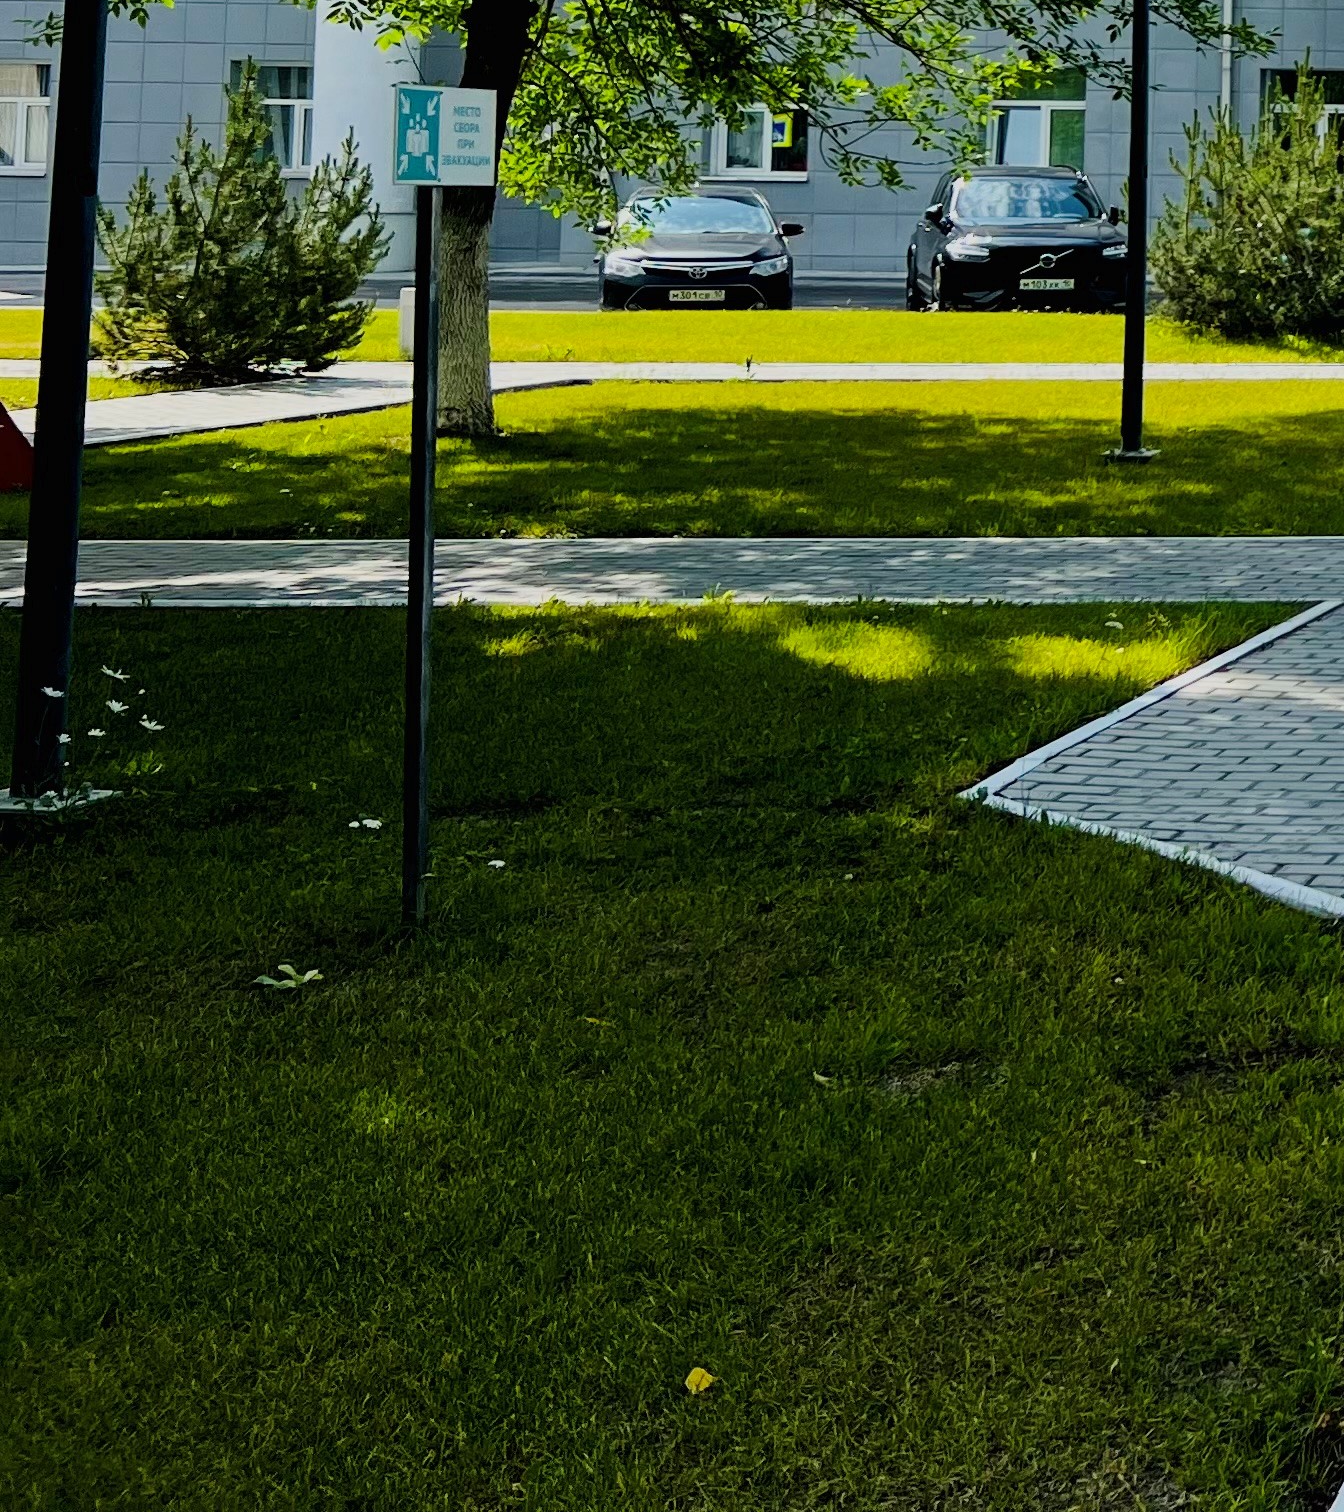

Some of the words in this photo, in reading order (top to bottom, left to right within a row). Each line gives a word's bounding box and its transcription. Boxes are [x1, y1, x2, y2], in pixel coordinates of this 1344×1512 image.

[453, 106, 481, 117] МЕСТО
[453, 122, 480, 133] СБОРА
[457, 138, 475, 149] ПРИ
[441, 154, 491, 166] ЭВАКУАЦИИ
